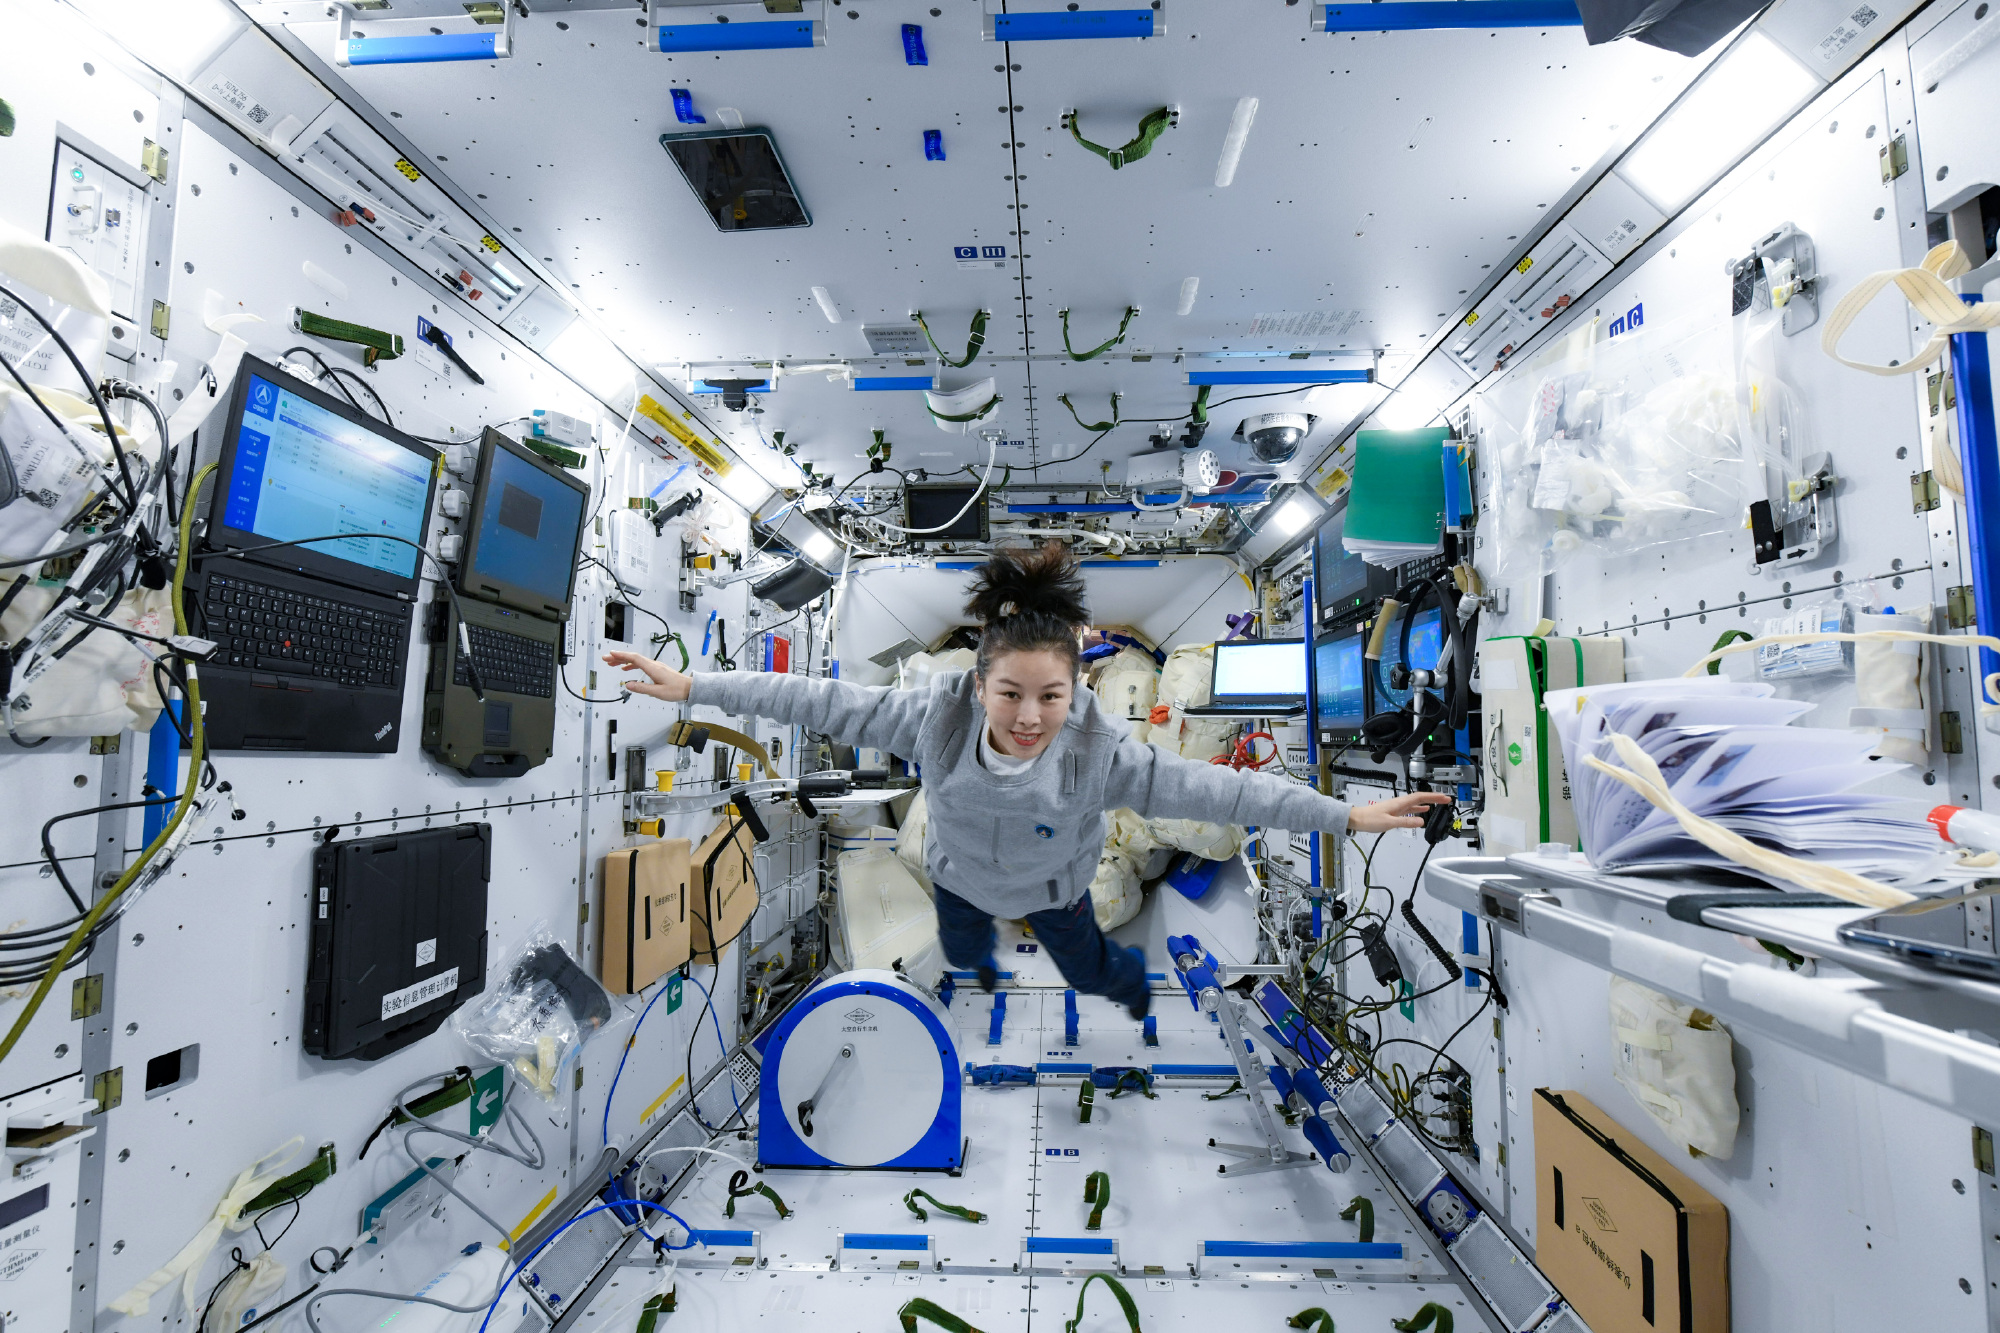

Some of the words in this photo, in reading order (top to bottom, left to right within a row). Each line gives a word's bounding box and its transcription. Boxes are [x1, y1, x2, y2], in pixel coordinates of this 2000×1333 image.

[960, 247, 971, 257] C
[983, 247, 1002, 257] III
[1630, 309, 1639, 328] C
[374, 721, 392, 742] ThinkPad
[382, 973, 459, 1016] 实验信息管理计算机
